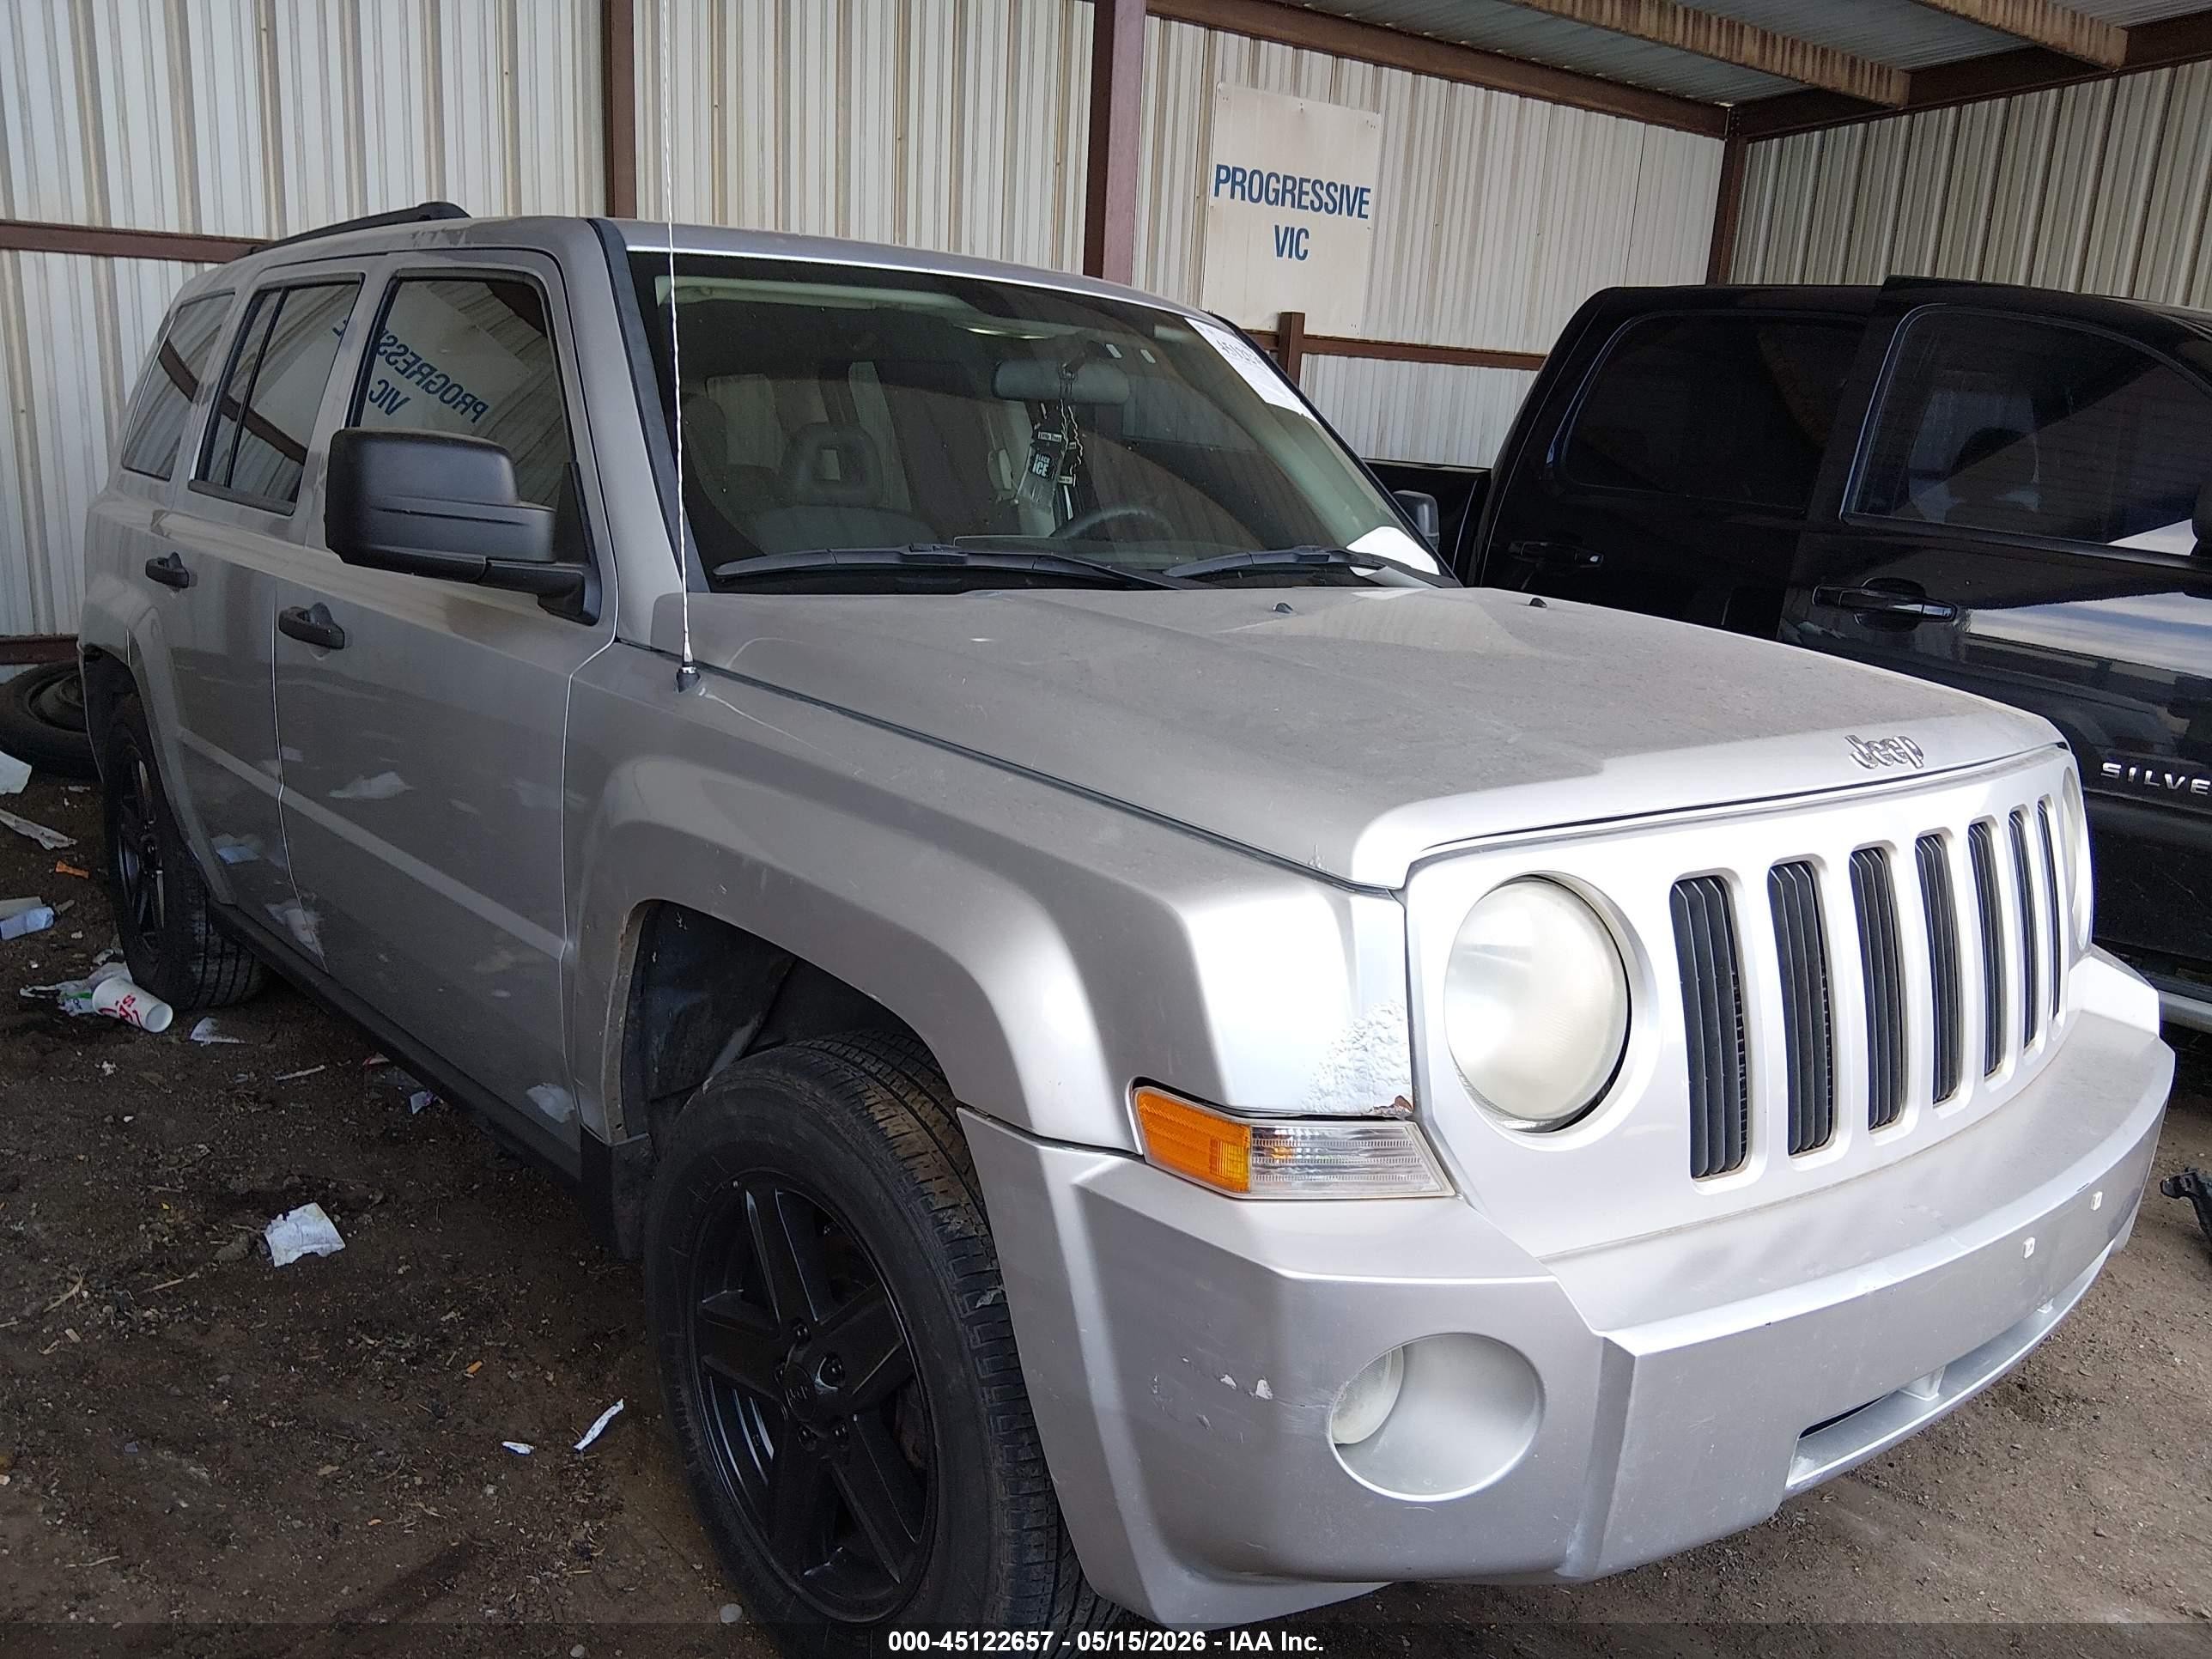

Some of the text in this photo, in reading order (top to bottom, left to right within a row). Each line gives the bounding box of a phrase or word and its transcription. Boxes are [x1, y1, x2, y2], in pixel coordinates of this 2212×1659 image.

[1213, 163, 1372, 220] PROGRESSIVE
[1273, 224, 1310, 261] VIC
[1032, 461, 1049, 477] ICE
[1035, 453, 1050, 464] BLACK
[1844, 734, 1924, 769] Jeep
[2100, 762, 2211, 795] SILVE
